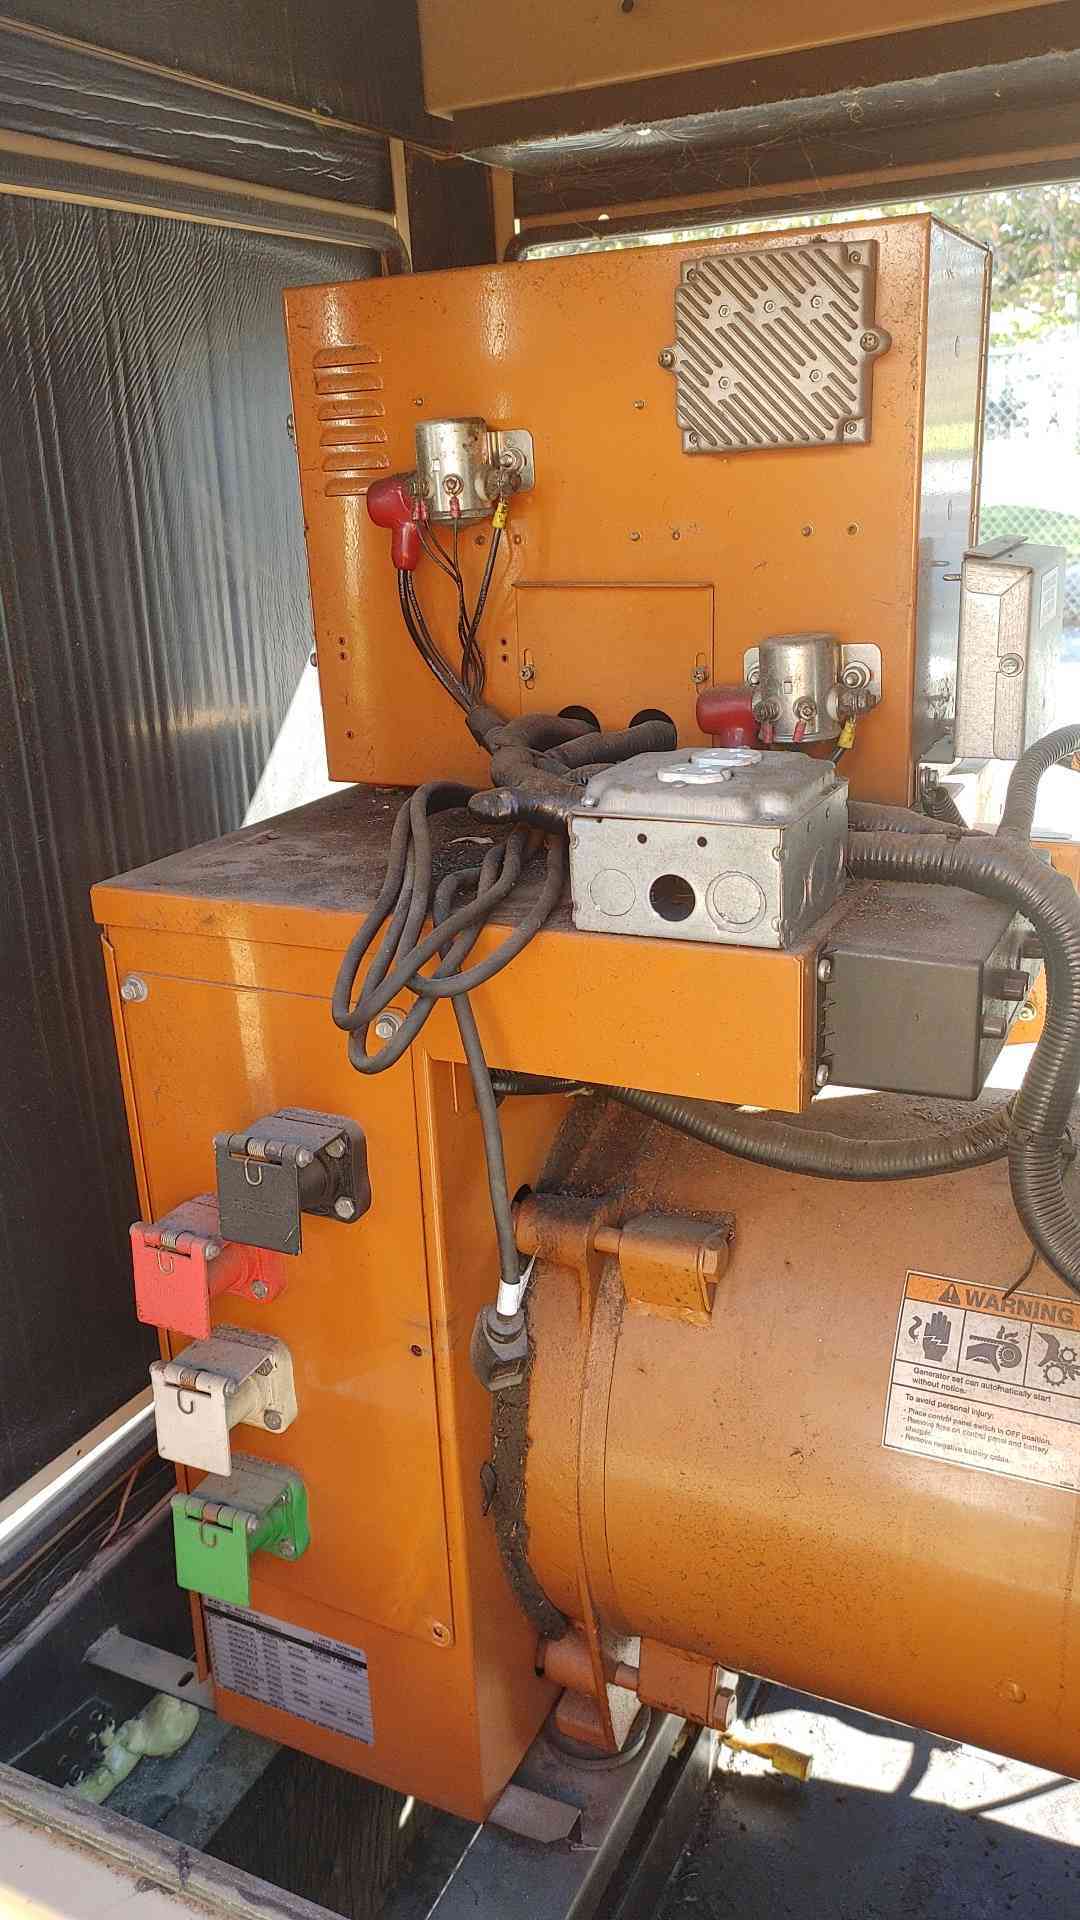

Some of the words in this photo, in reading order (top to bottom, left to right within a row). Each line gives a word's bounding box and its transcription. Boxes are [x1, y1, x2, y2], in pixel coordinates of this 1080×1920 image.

[965, 1288, 1073, 1324] WARNING
[912, 1377, 940, 1388] without
[913, 1367, 950, 1381] Generator
[951, 1376, 964, 1384] set
[965, 1379, 979, 1388] can
[980, 1382, 1033, 1399] automatically
[1033, 1393, 1052, 1402] start
[905, 1393, 914, 1401] To
[915, 1396, 936, 1406] avoid
[937, 1401, 970, 1414] personal
[1005, 1429, 1020, 1438] OFF
[1008, 1440, 1022, 1449] and
